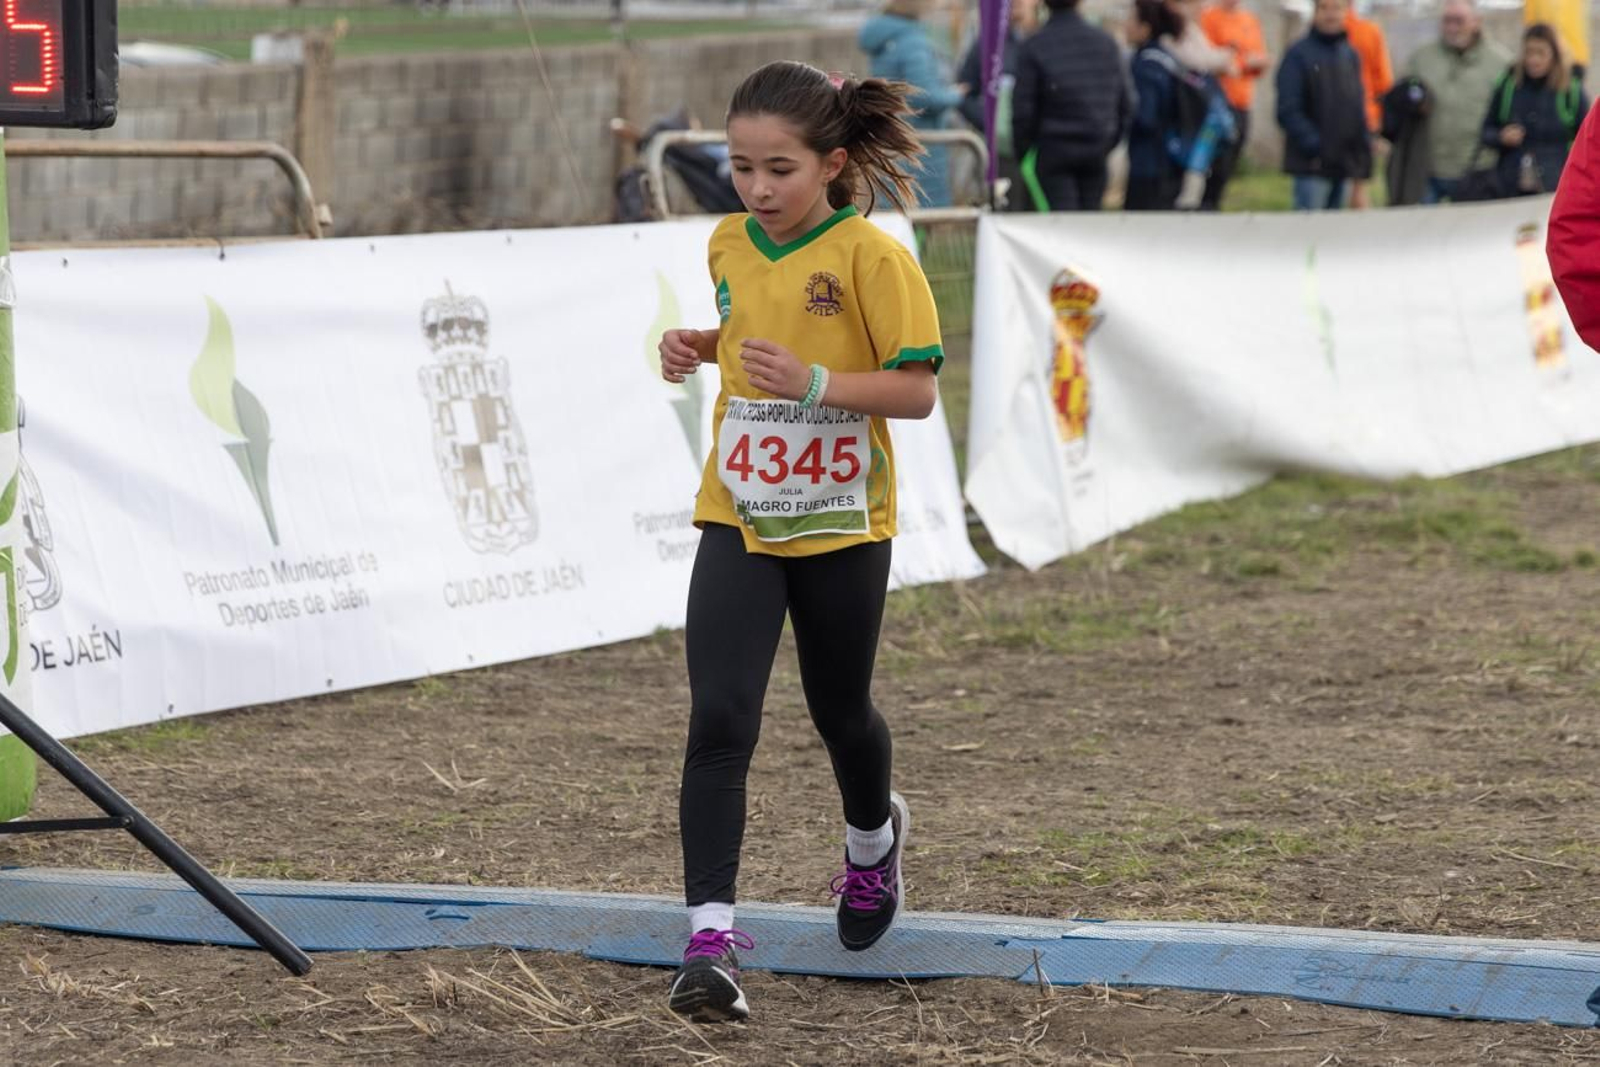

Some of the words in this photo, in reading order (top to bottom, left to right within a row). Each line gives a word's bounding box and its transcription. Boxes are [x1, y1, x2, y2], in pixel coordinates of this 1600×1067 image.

[5, 0, 54, 92] 5
[767, 403, 804, 424] POPULAR
[726, 433, 861, 485] 4345
[741, 499, 792, 512] MAGRO
[796, 495, 855, 512] FUENTES
[778, 488, 803, 496] JULIA
[183, 566, 270, 596] Patronato
[270, 554, 354, 584] Municipal
[357, 550, 378, 573] de
[442, 574, 511, 609] CIUDAD
[511, 570, 539, 598] DE
[217, 597, 300, 629] Deportes
[302, 591, 326, 615] de
[329, 582, 371, 611] Jaén
[62, 624, 123, 667] JAÉN
